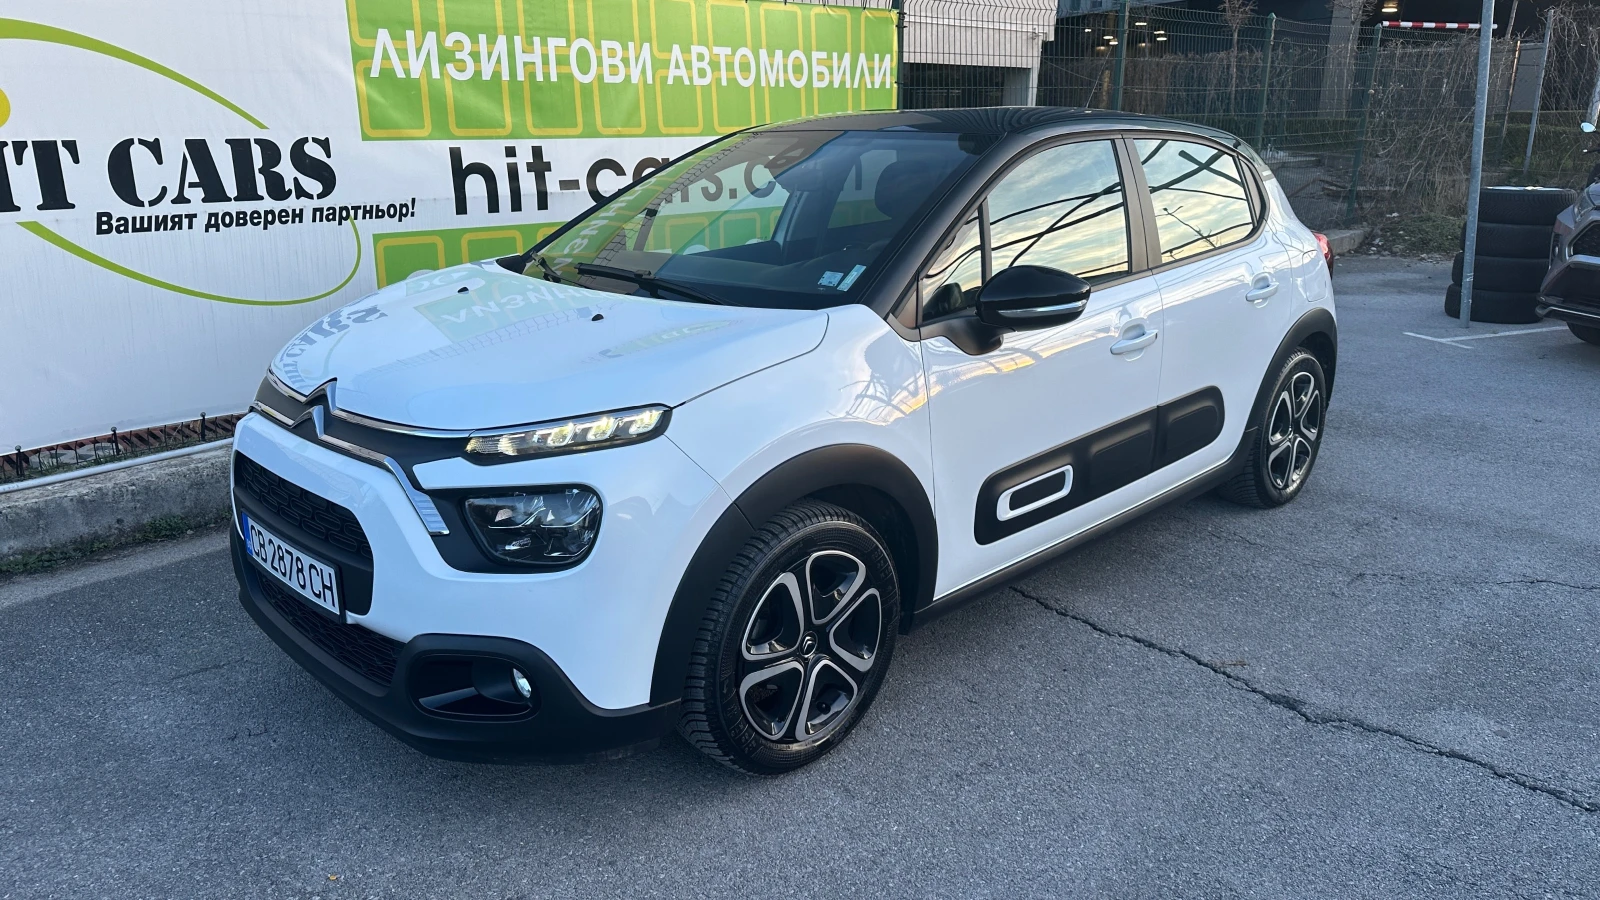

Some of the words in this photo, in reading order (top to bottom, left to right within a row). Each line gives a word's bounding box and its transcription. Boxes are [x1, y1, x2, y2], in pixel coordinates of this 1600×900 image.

[369, 28, 654, 85] ЛИЗИНГОВИ
[666, 43, 892, 90] АВТОМОБИЛИ
[107, 136, 337, 208] CARS
[96, 211, 197, 236] Вашият
[205, 207, 303, 233] доверен
[311, 197, 416, 228] партньор!
[250, 525, 268, 563] CB
[268, 538, 307, 590] 2878
[308, 563, 336, 608] CH
